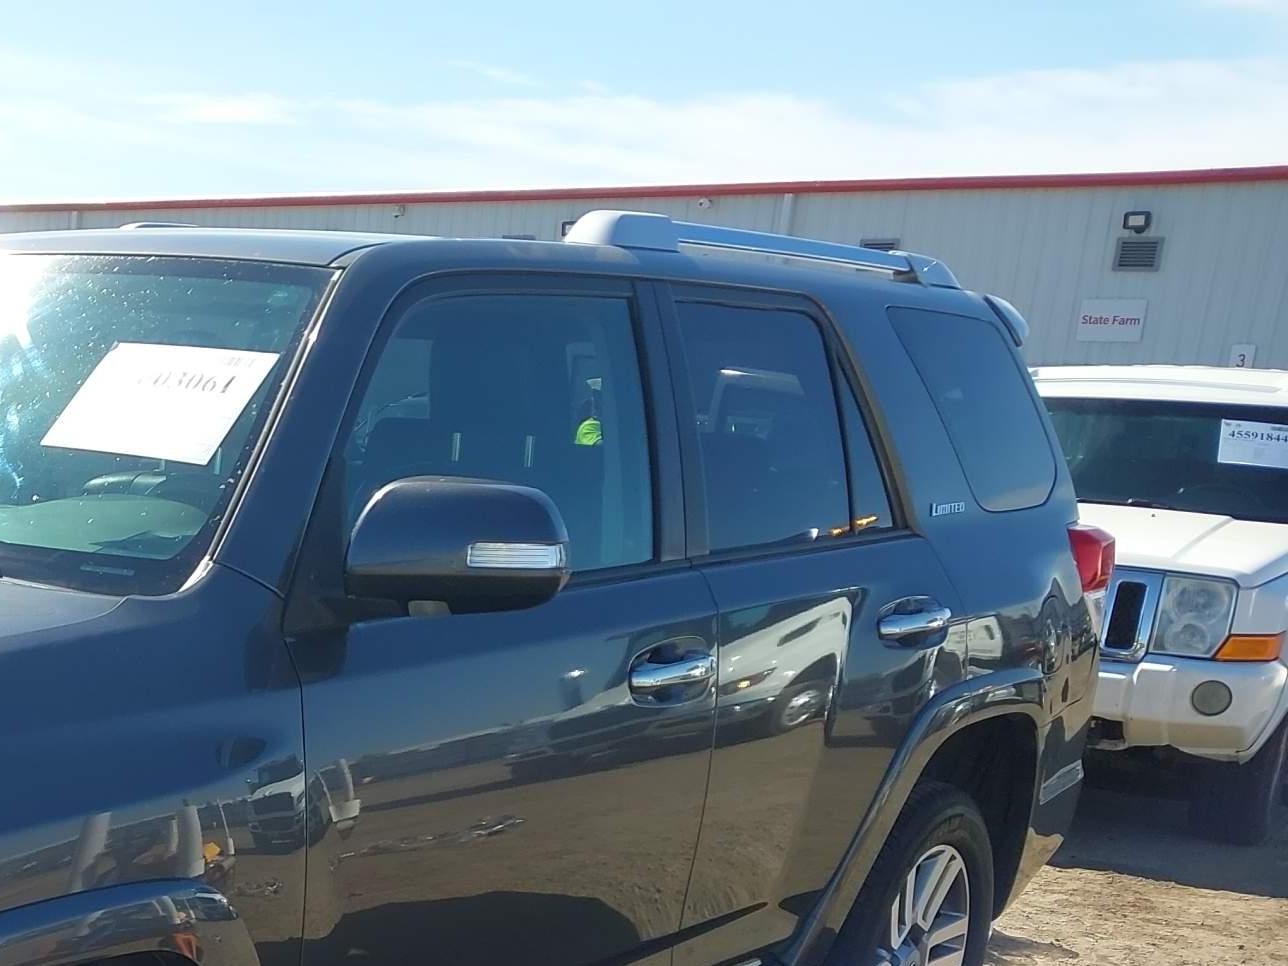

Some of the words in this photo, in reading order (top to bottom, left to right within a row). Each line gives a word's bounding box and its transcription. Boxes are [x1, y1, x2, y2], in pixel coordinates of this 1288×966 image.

[1080, 314, 1110, 326] State
[1111, 315, 1141, 326] Farm
[1235, 353, 1246, 368] 3
